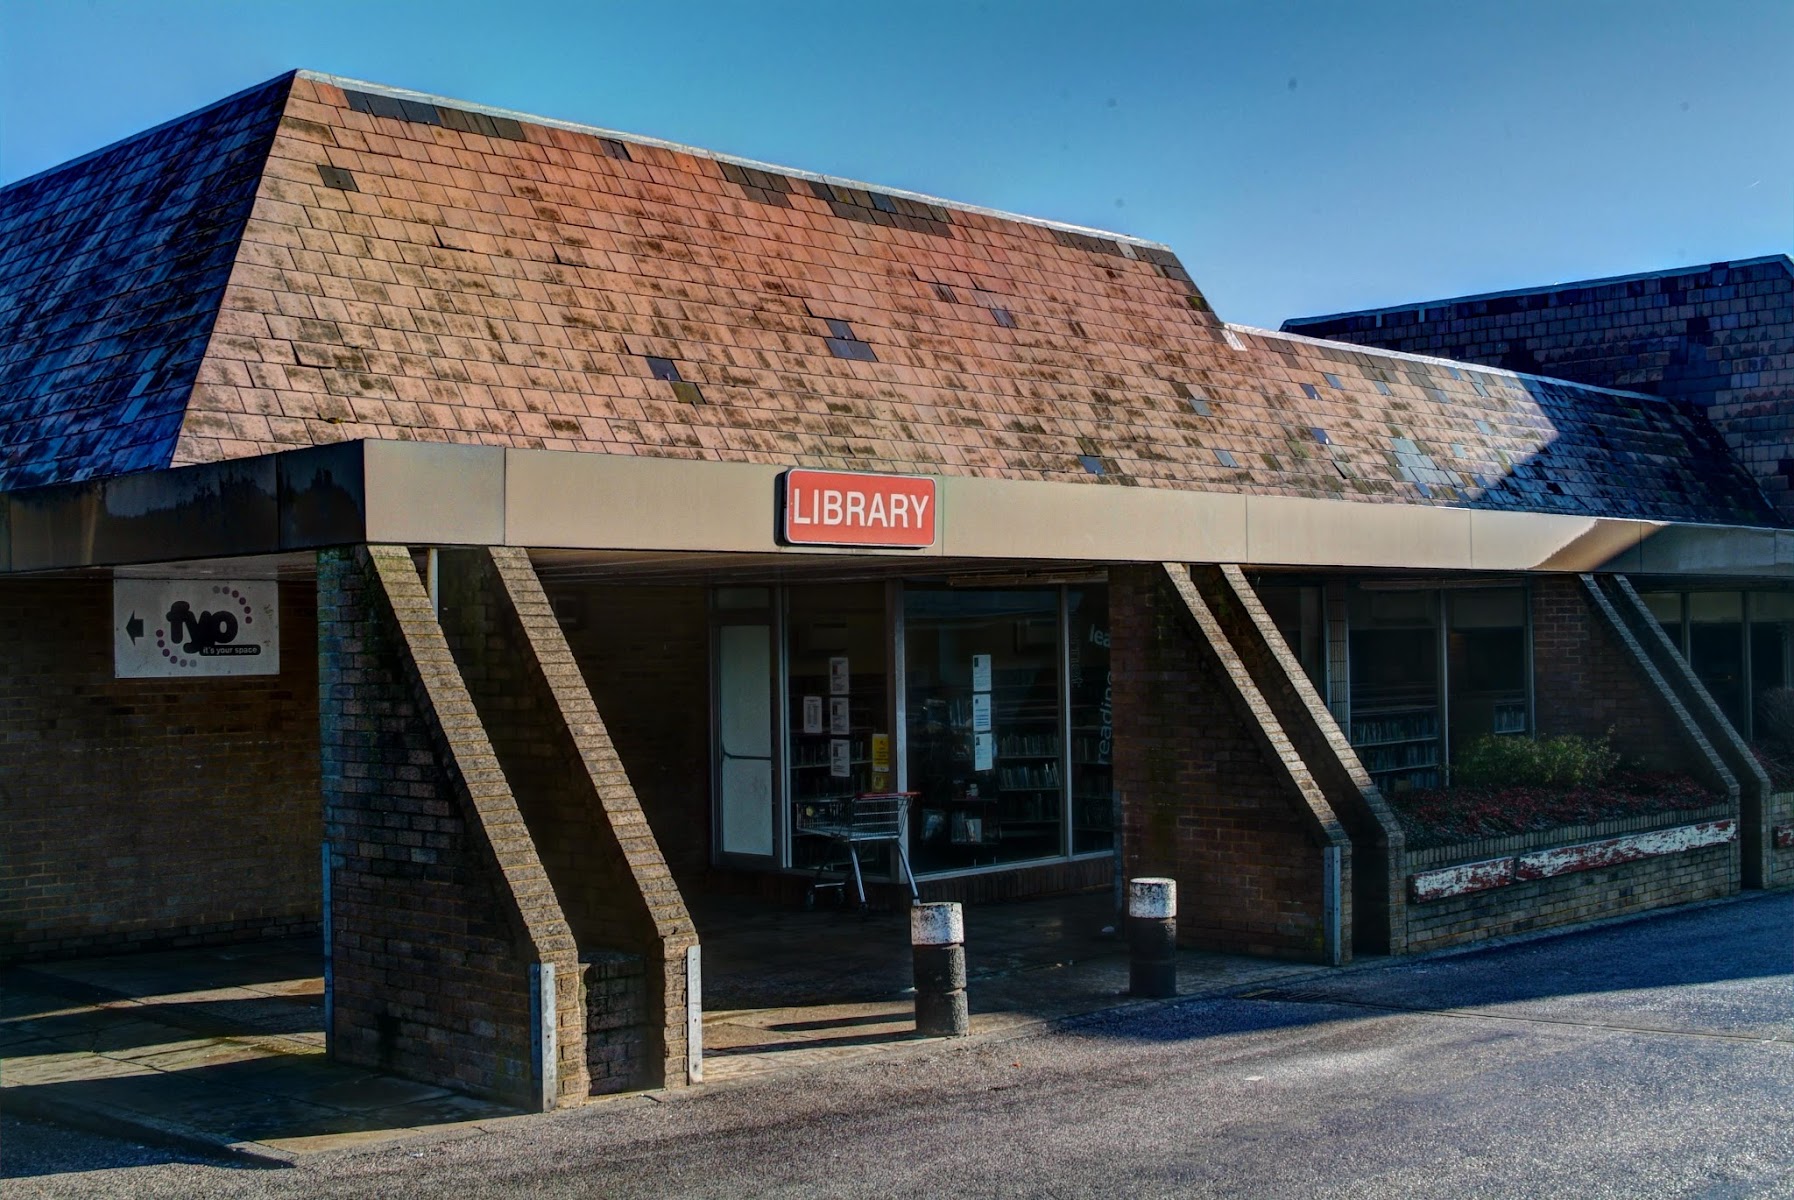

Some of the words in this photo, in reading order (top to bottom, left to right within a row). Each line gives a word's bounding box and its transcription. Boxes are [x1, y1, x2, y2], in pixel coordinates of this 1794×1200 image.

[793, 488, 929, 528] LIBRARY
[202, 646, 215, 655] it's
[216, 647, 233, 655] your
[234, 647, 258, 655] space
